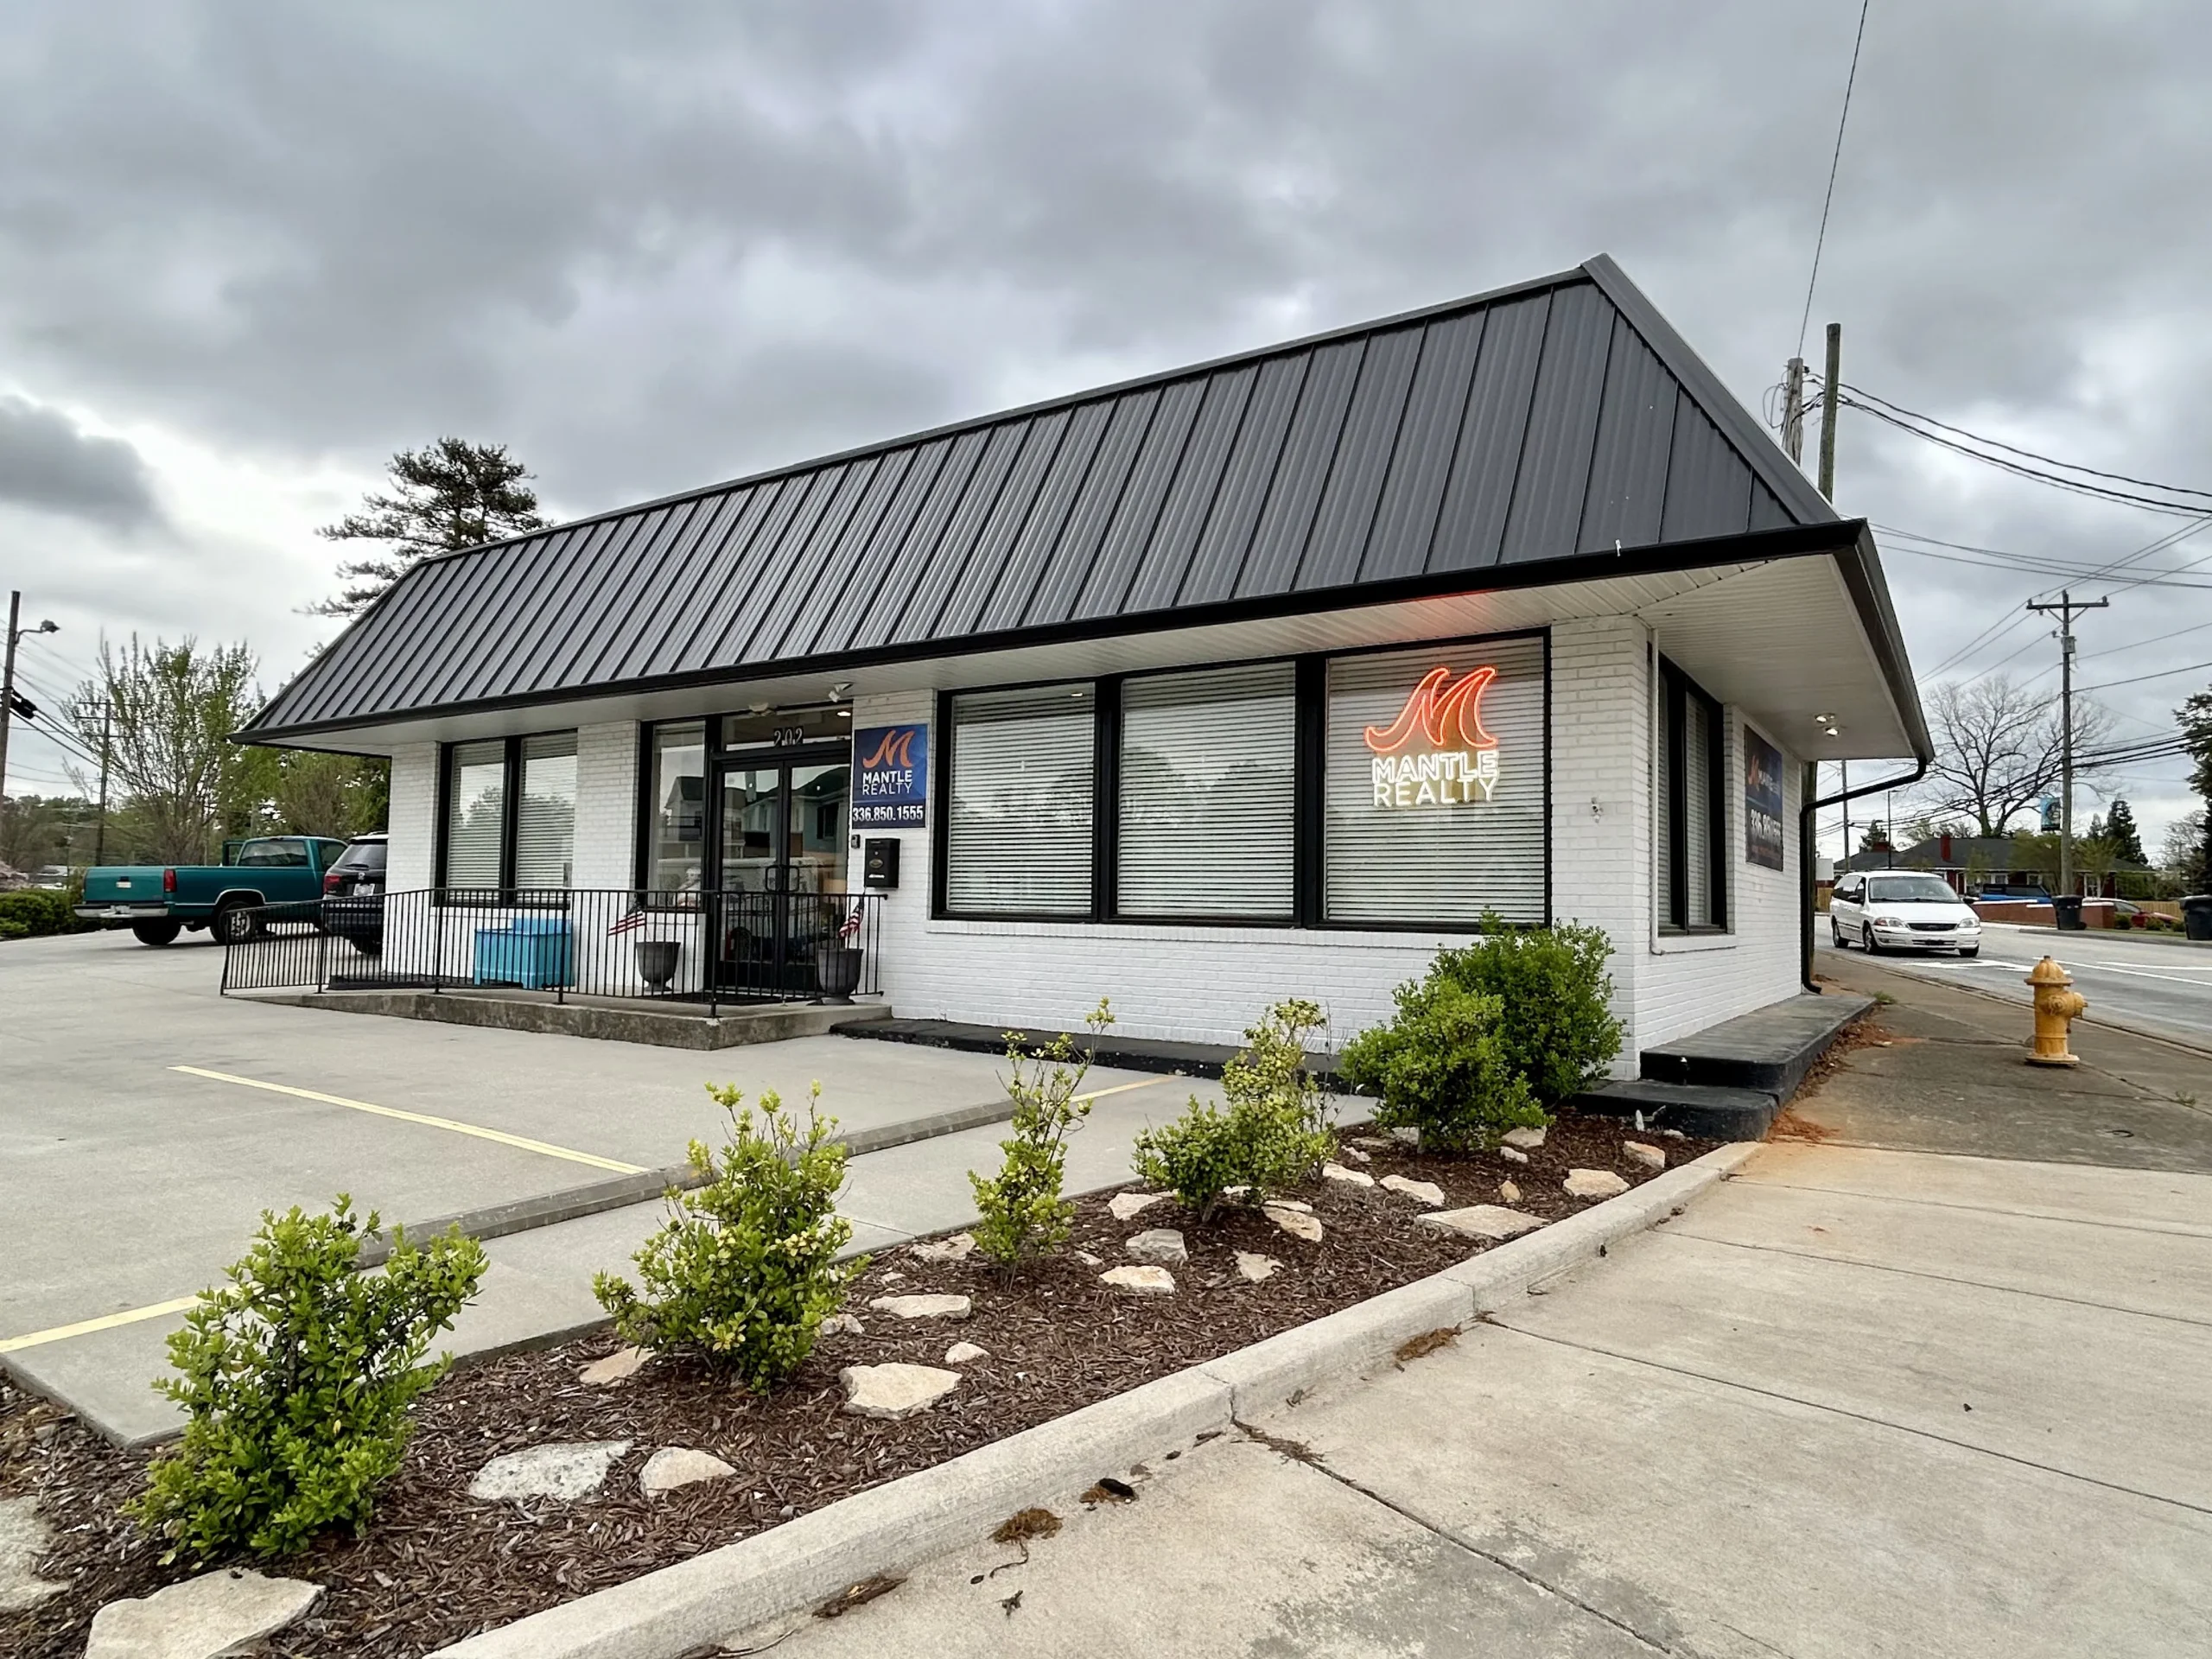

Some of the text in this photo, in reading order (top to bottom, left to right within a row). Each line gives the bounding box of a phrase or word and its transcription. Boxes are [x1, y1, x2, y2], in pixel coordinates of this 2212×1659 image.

[773, 728, 803, 747] 202
[1371, 749, 1499, 784] MANTLE
[862, 770, 913, 784] MANTLE
[862, 782, 913, 796] REALTY
[1373, 777, 1497, 807] REALTY
[852, 805, 924, 822] 336.850.1555
